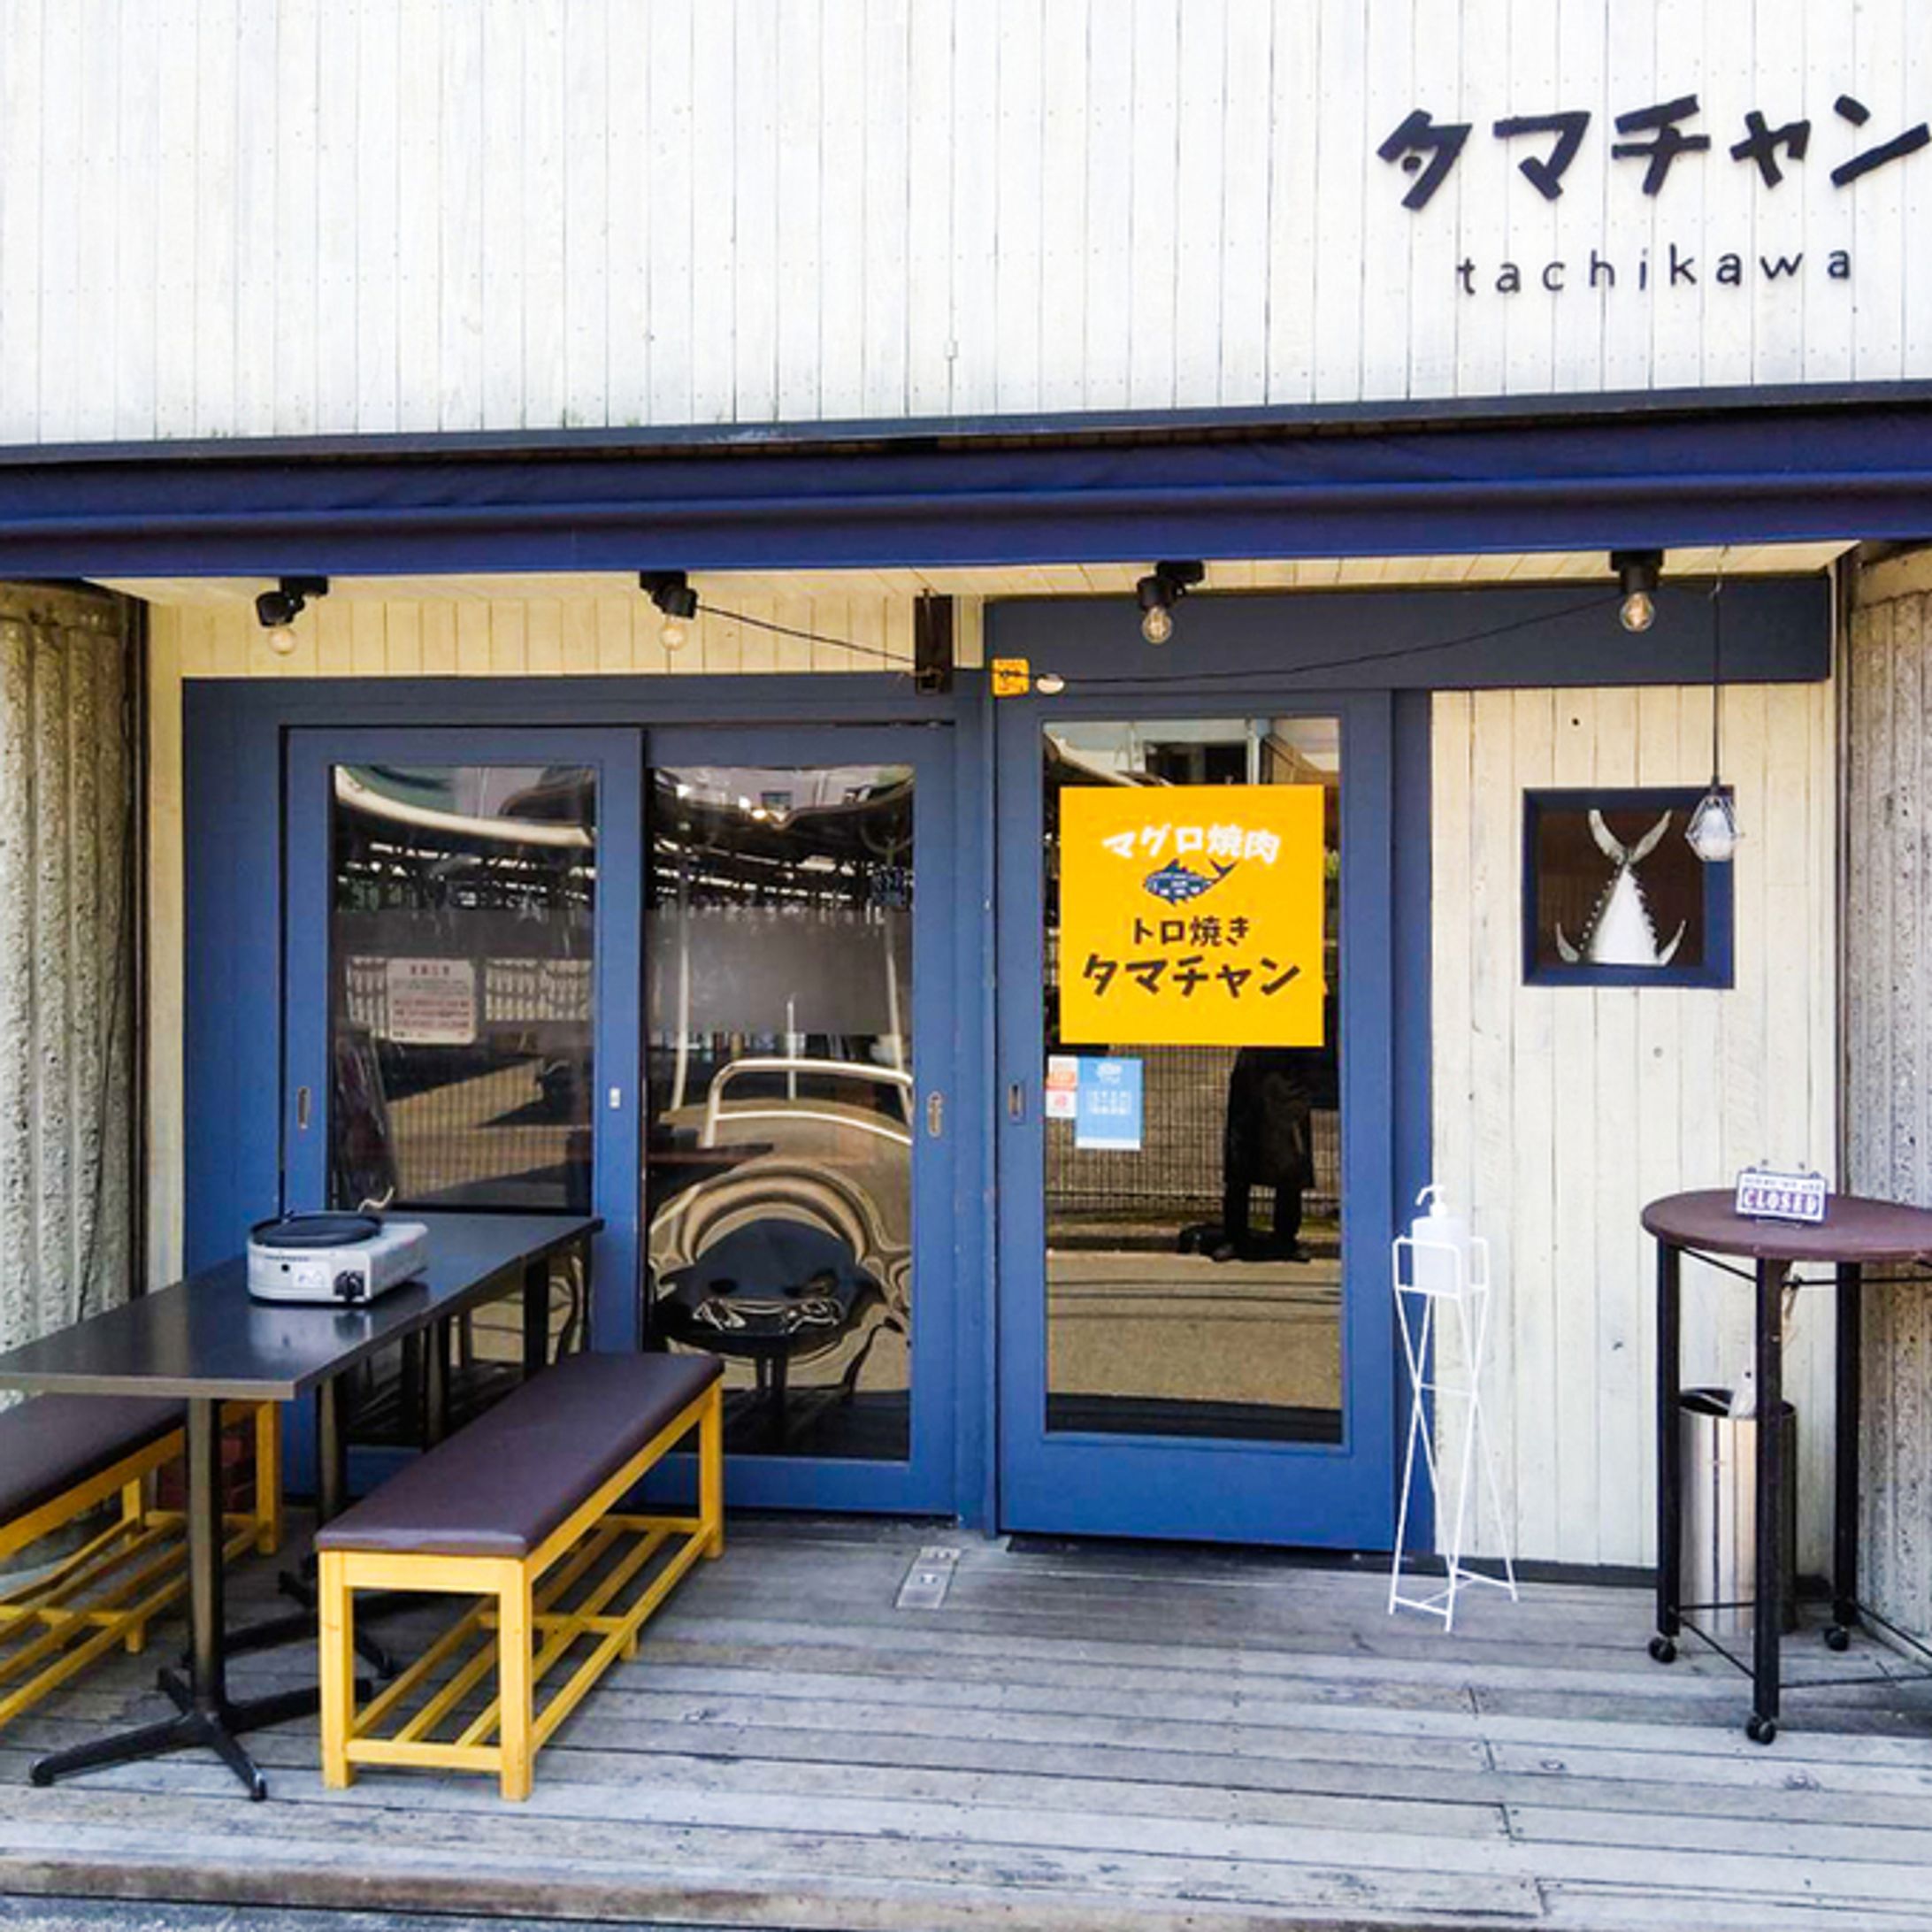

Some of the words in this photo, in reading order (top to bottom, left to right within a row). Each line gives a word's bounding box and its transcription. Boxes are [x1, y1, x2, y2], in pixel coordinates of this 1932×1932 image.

[1376, 94, 1932, 212] タマチャン
[1456, 242, 1852, 295] tachikawa
[1100, 822, 1283, 865] マグロ焼肉
[1133, 915, 1250, 947] トロ焼き
[1082, 952, 1301, 999] タマチャン
[1743, 1190, 1819, 1215] CLOSED
